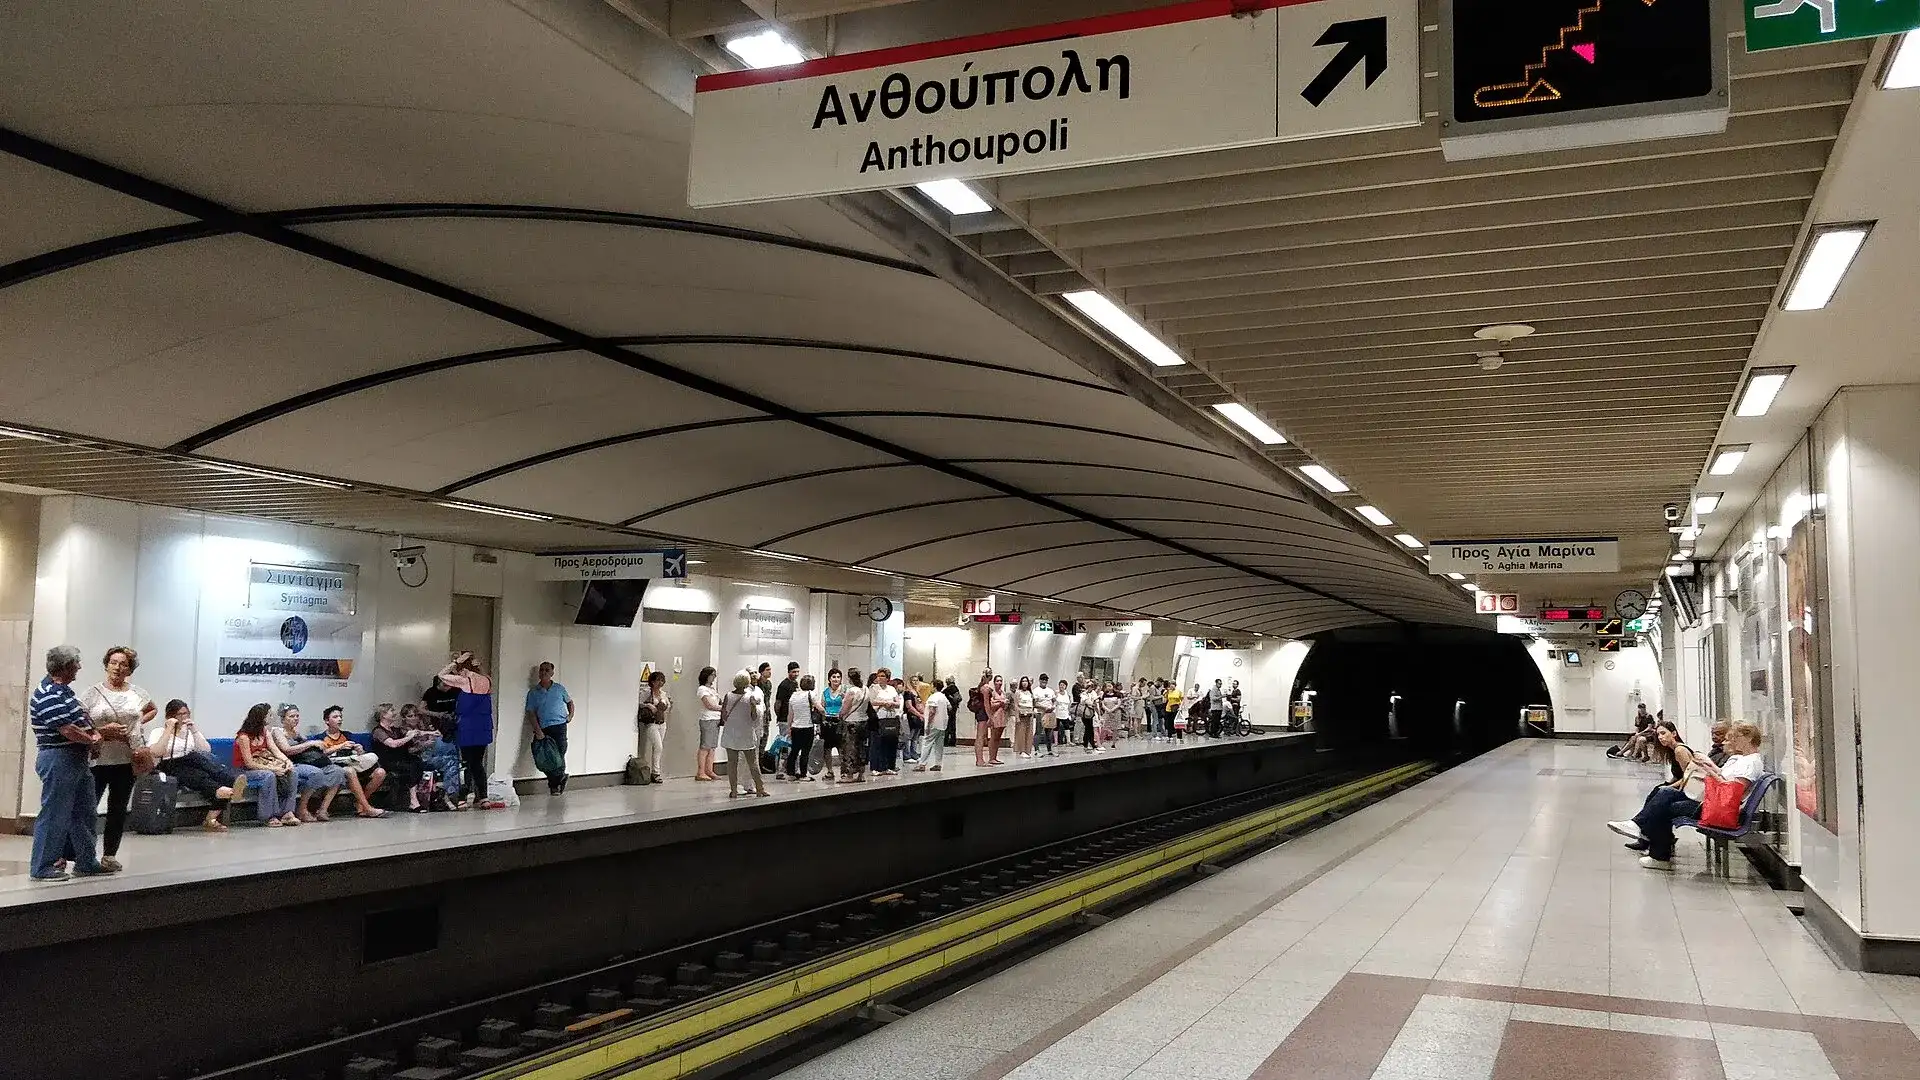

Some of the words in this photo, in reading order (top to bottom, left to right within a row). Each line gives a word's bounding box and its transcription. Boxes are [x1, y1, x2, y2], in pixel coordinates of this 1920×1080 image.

[812, 50, 1129, 129] Ανθούπολη
[860, 118, 1067, 173] Anthoupoli
[1452, 546, 1489, 560] Προς
[1497, 546, 1530, 560] Αγία
[1539, 545, 1595, 557] Μαρίνα
[555, 558, 579, 568] Προς
[582, 556, 643, 568] Αεροδρόμιο
[1483, 562, 1494, 570] To
[1498, 561, 1526, 571] Aghia
[1530, 561, 1563, 569] Marina
[592, 569, 616, 577] Airport
[281, 593, 328, 607] Syntagma
